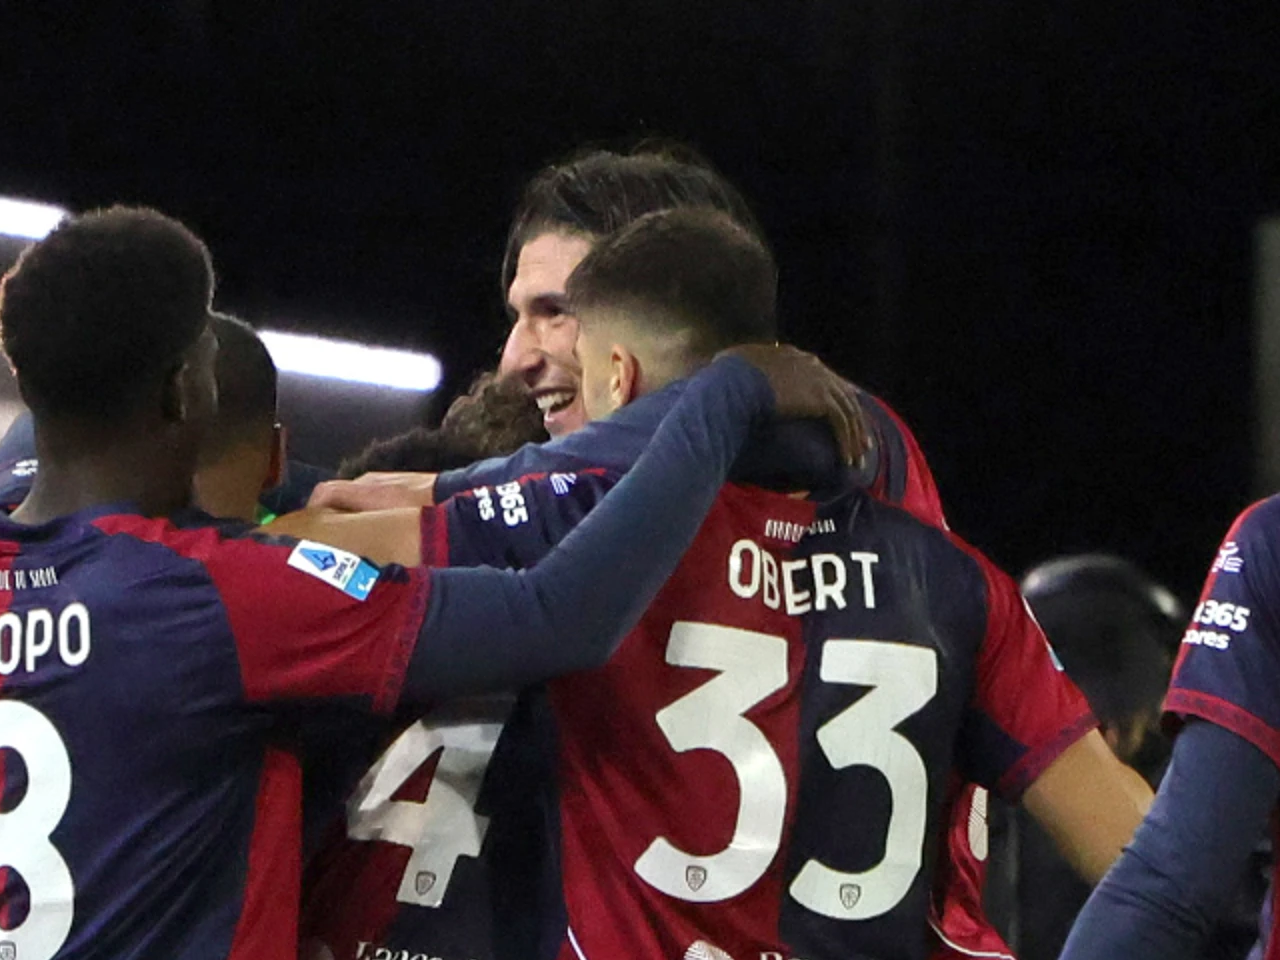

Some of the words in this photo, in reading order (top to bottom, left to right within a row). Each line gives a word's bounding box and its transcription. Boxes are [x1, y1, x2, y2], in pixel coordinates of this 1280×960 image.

[728, 538, 880, 615] OBERT
[345, 719, 505, 909] 4
[634, 620, 939, 921] 33
